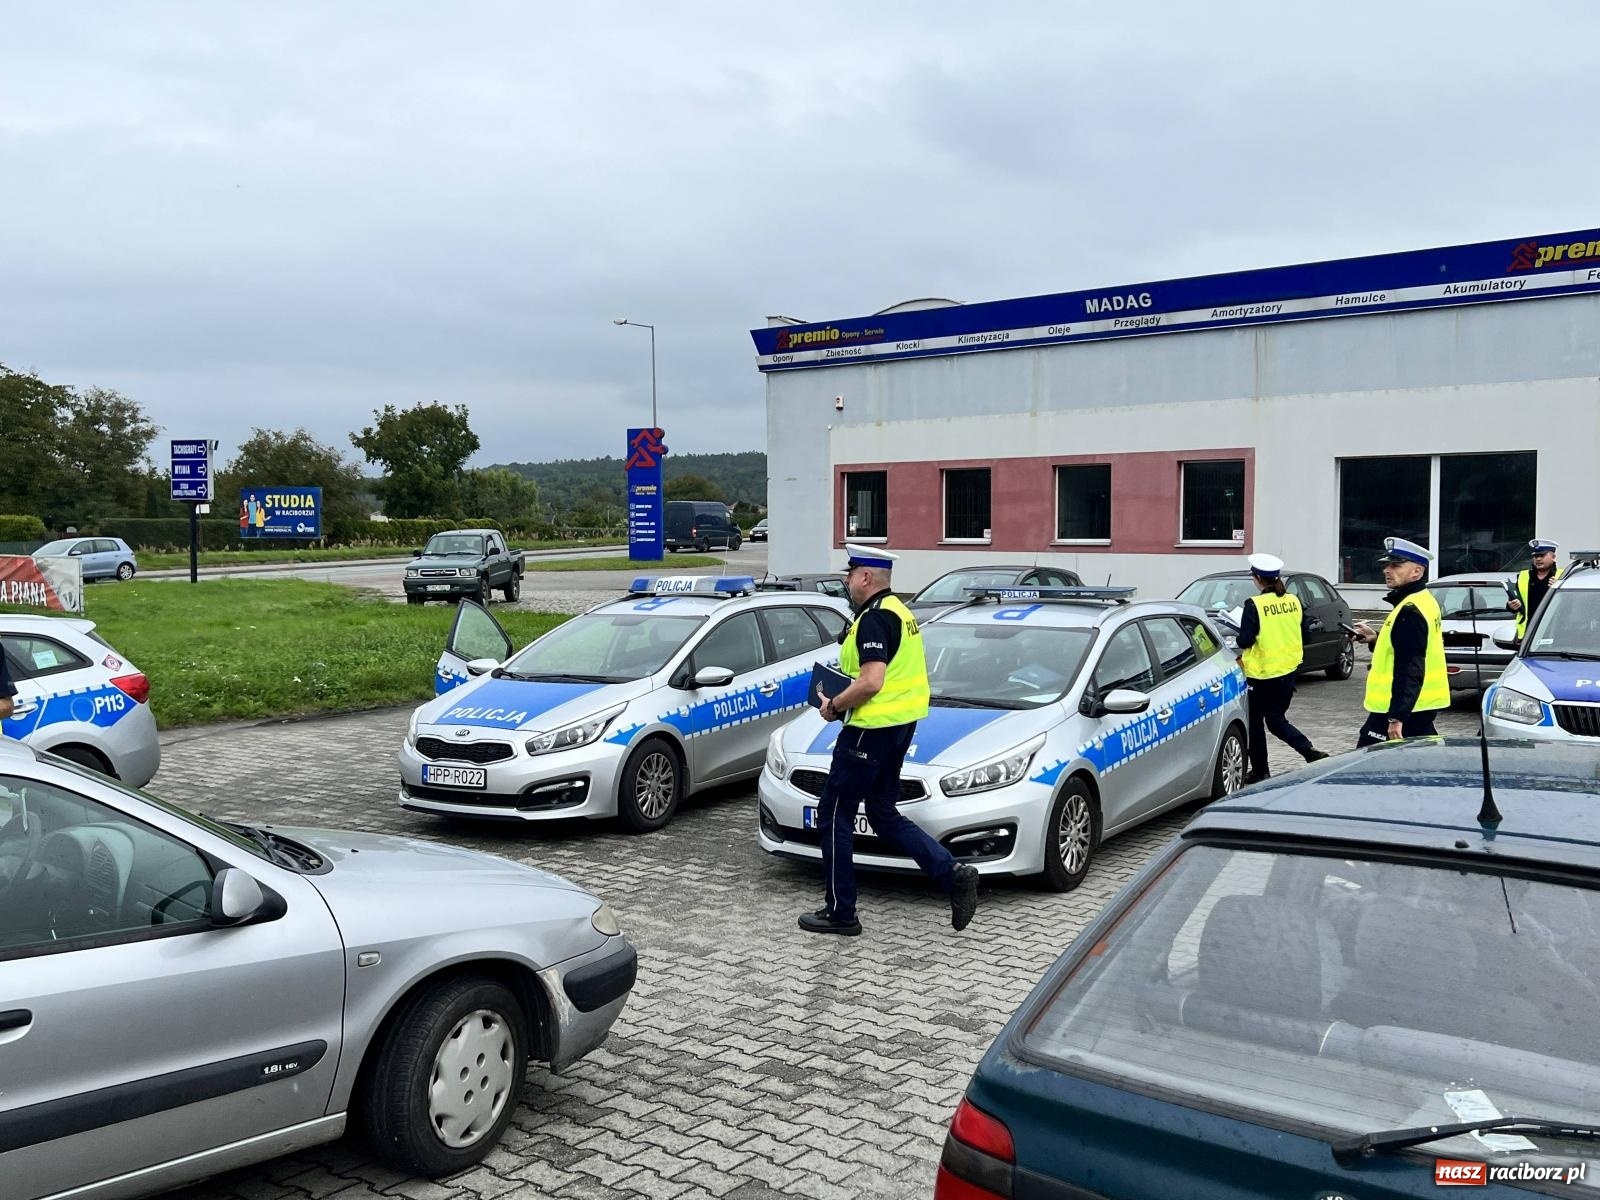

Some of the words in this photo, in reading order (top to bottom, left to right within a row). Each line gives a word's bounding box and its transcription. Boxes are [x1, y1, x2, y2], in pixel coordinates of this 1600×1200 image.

[1443, 279, 1526, 295] Akumulatory
[1085, 292, 1152, 314] MADAG
[1335, 293, 1386, 306] Hamulce
[1211, 304, 1282, 318] Amortyzatory
[1114, 315, 1161, 328] Przeglądy
[789, 325, 840, 348] premio
[1048, 325, 1071, 336] Oleje
[958, 332, 1010, 345] Klimatyzacja
[826, 347, 862, 358] Zbieżność
[896, 341, 920, 351] Klocki
[773, 355, 794, 364] Opony
[265, 494, 315, 508] STUDIA
[655, 579, 693, 591] POLICJA
[11, 581, 48, 607] PIANA
[1001, 590, 1039, 598] POLICJA
[1263, 602, 1299, 617] POLICJA
[863, 641, 883, 649] POLICJA
[94, 694, 125, 714] P113
[713, 693, 758, 720] POLICJA
[443, 707, 528, 724] POLICJA
[456, 729, 470, 737] KIA
[1120, 717, 1159, 755] POLICJA
[429, 768, 452, 783] HPP
[454, 770, 484, 786] R022
